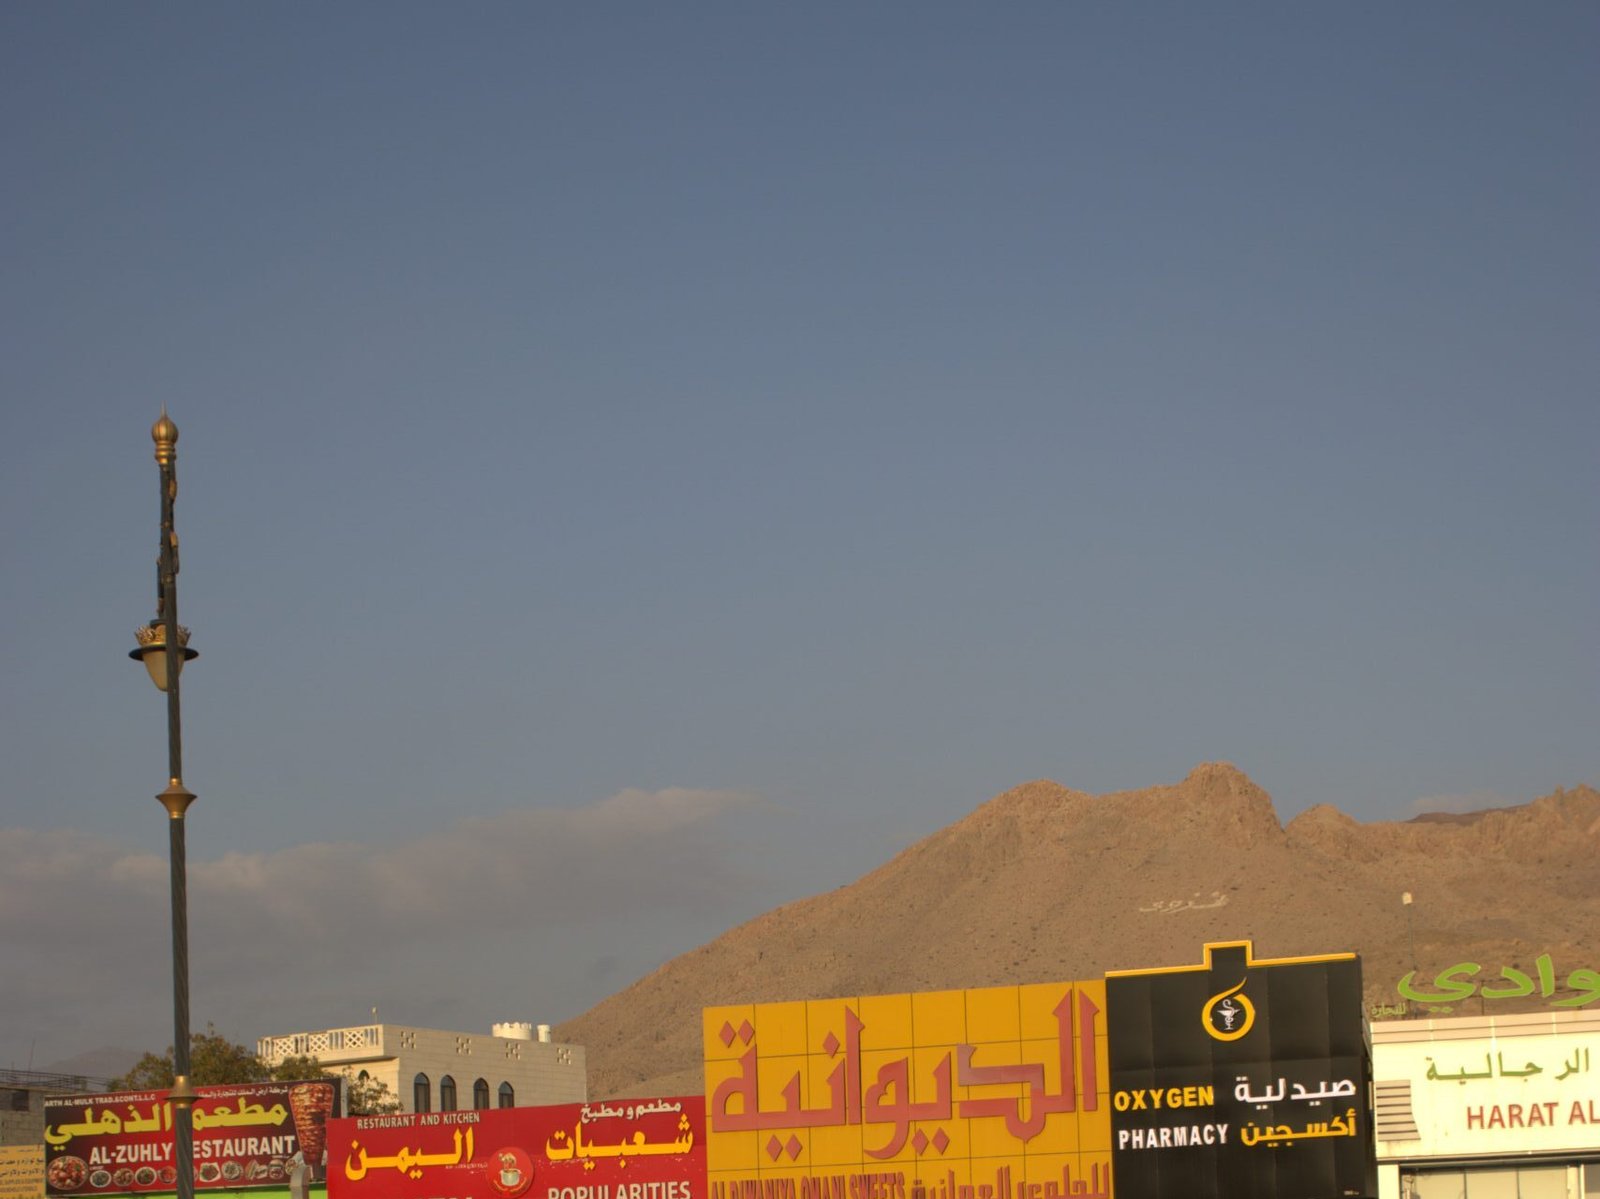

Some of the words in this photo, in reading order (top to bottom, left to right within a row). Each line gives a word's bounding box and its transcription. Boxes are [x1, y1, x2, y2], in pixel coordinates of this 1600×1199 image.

[711, 988, 1100, 1162] الديوانية
[1113, 1085, 1215, 1111] OXYGEN
[1234, 1076, 1357, 1110] صيدلية
[192, 1096, 288, 1131] مطعم
[356, 1115, 416, 1130] RESTAURANT
[420, 1114, 441, 1126] AND
[443, 1111, 481, 1125] KITCHEN
[579, 1103, 625, 1124] مطبخ
[626, 1107, 635, 1120] و
[635, 1099, 682, 1120] مطعم
[1466, 1101, 1559, 1130] HARAT
[1567, 1099, 1600, 1125] AL
[43, 1101, 173, 1152] الذهلي
[545, 1113, 694, 1170] شعبيات
[1118, 1123, 1229, 1150] PHARMACY
[1240, 1108, 1357, 1147] أكسجين
[89, 1142, 174, 1165] AL-ZUHLY
[192, 1134, 296, 1160] ESTAURANT
[344, 1126, 475, 1181] اليمن
